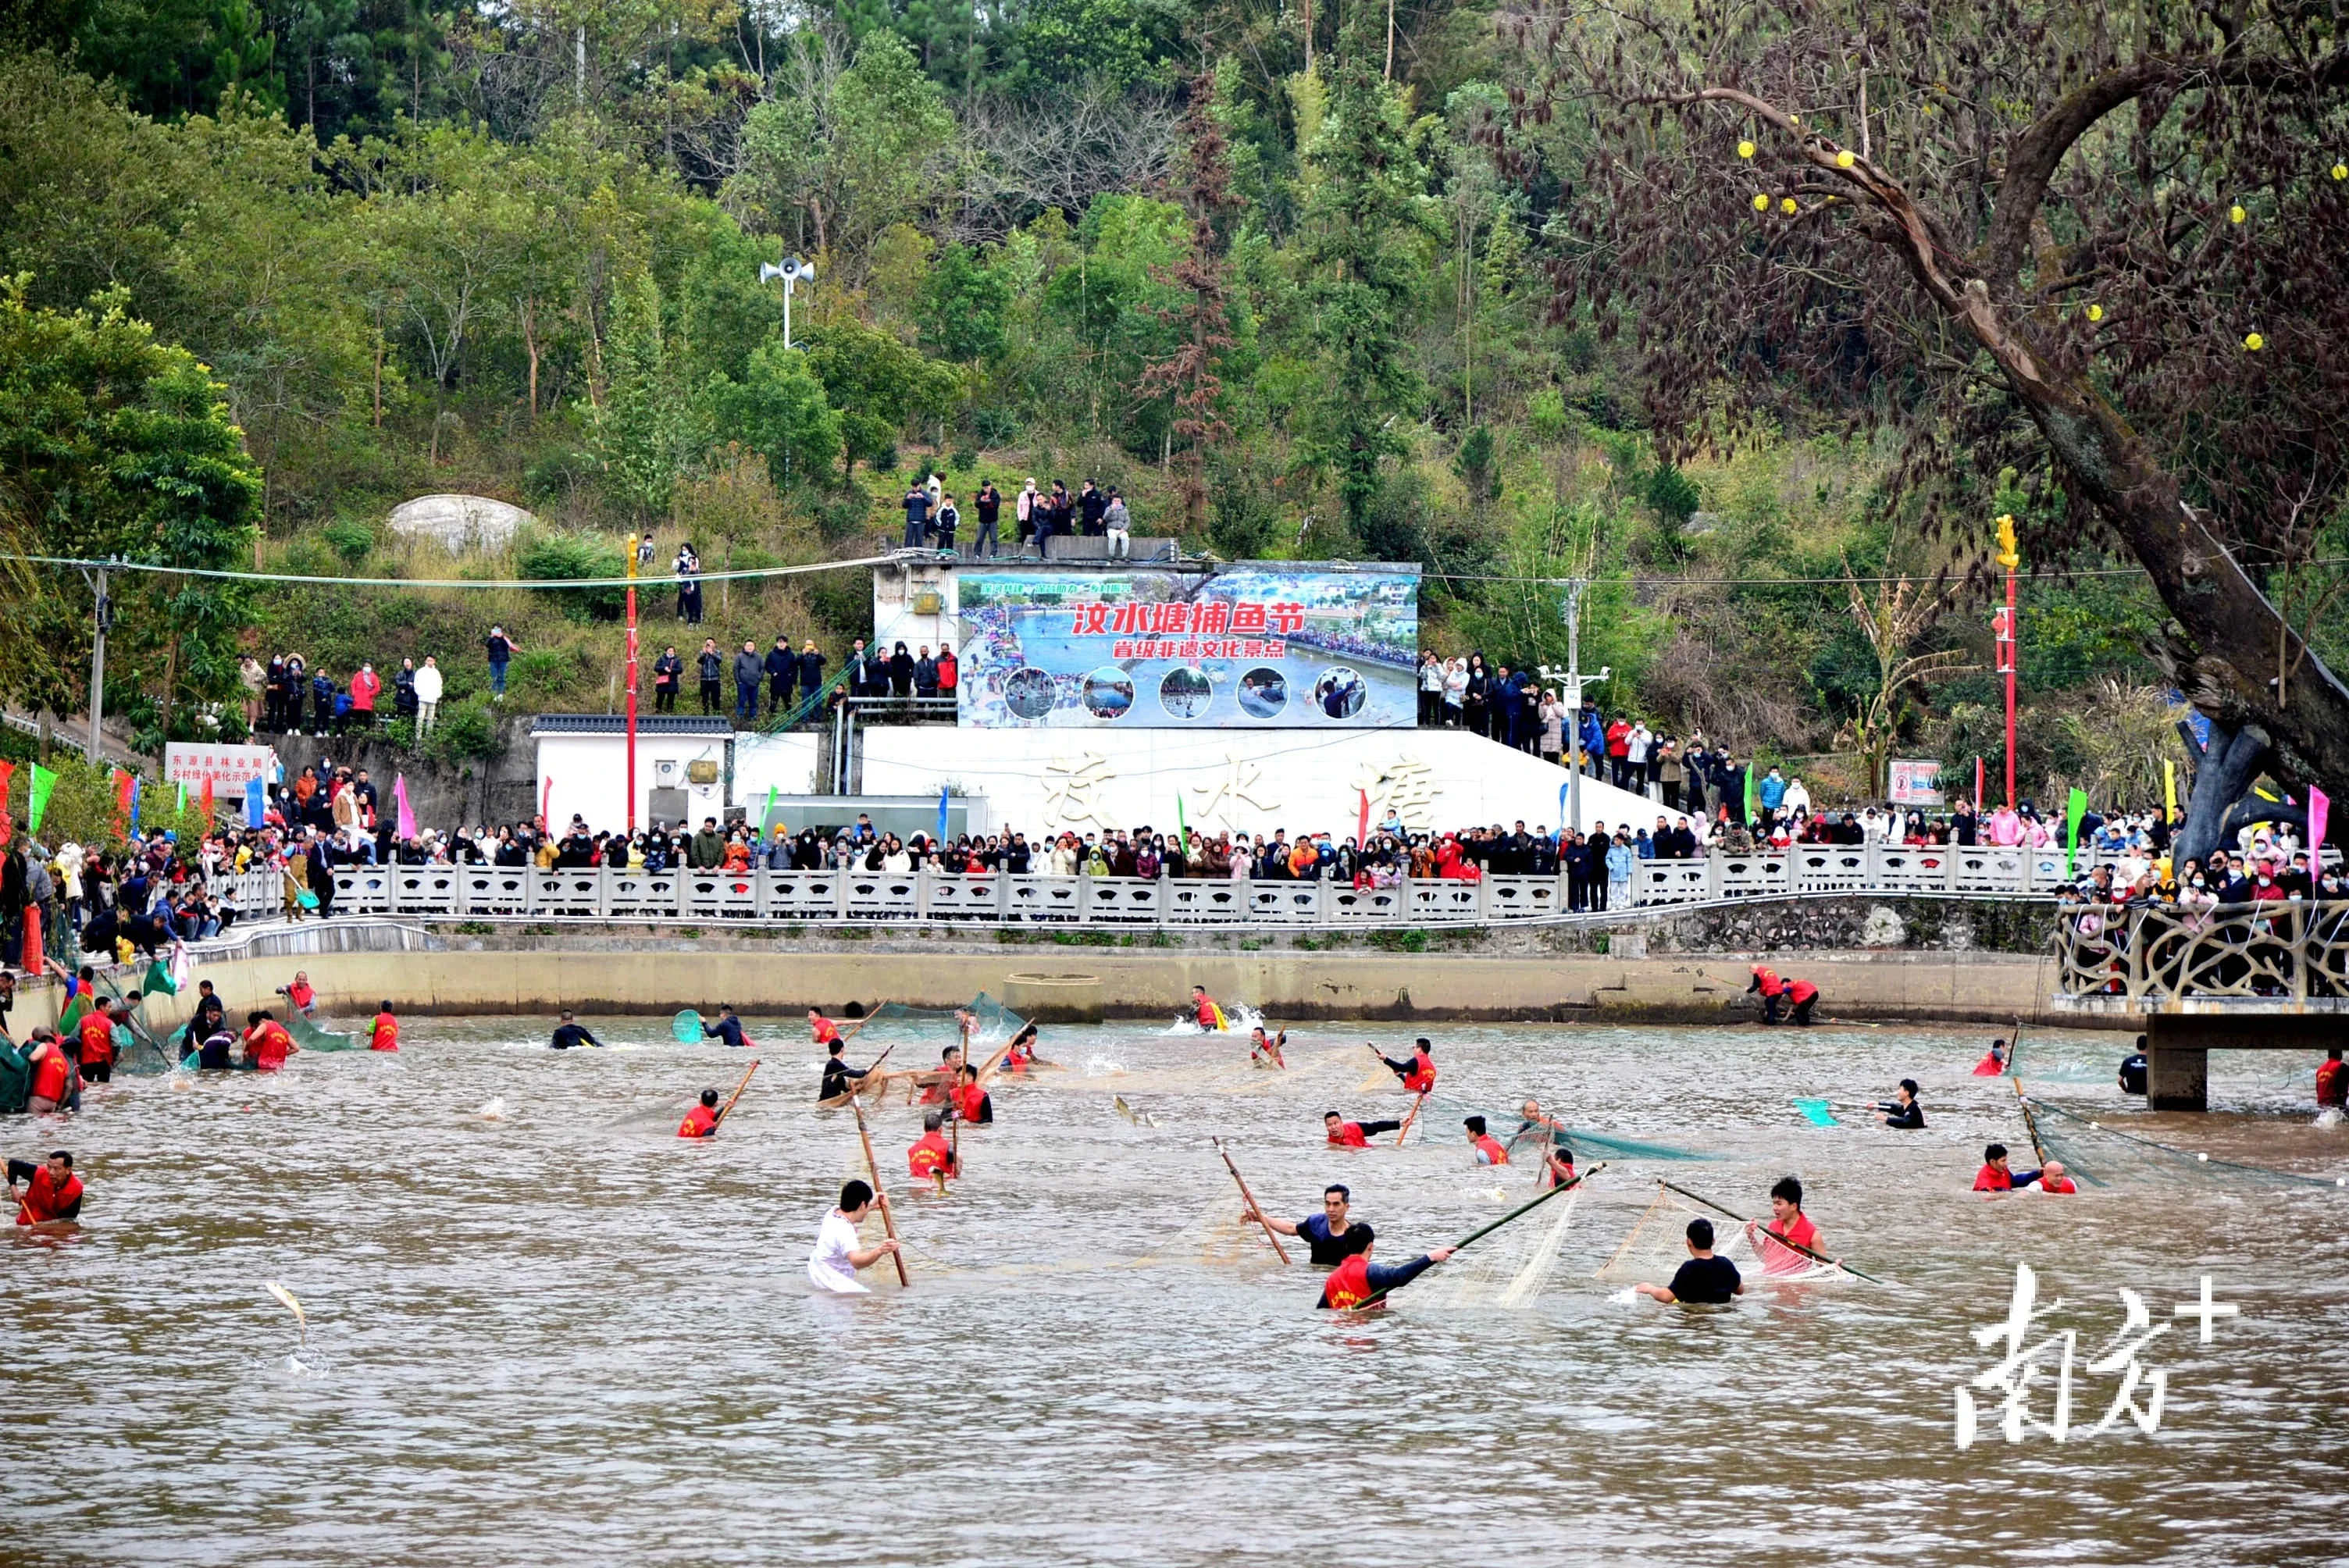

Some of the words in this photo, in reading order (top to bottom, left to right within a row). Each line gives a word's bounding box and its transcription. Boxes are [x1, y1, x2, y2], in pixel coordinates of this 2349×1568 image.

[1071, 601, 1306, 636] 汶水塘捕鱼节
[1112, 639, 1286, 660] 省级非遗文化景点
[173, 754, 262, 769] 东源县林业局
